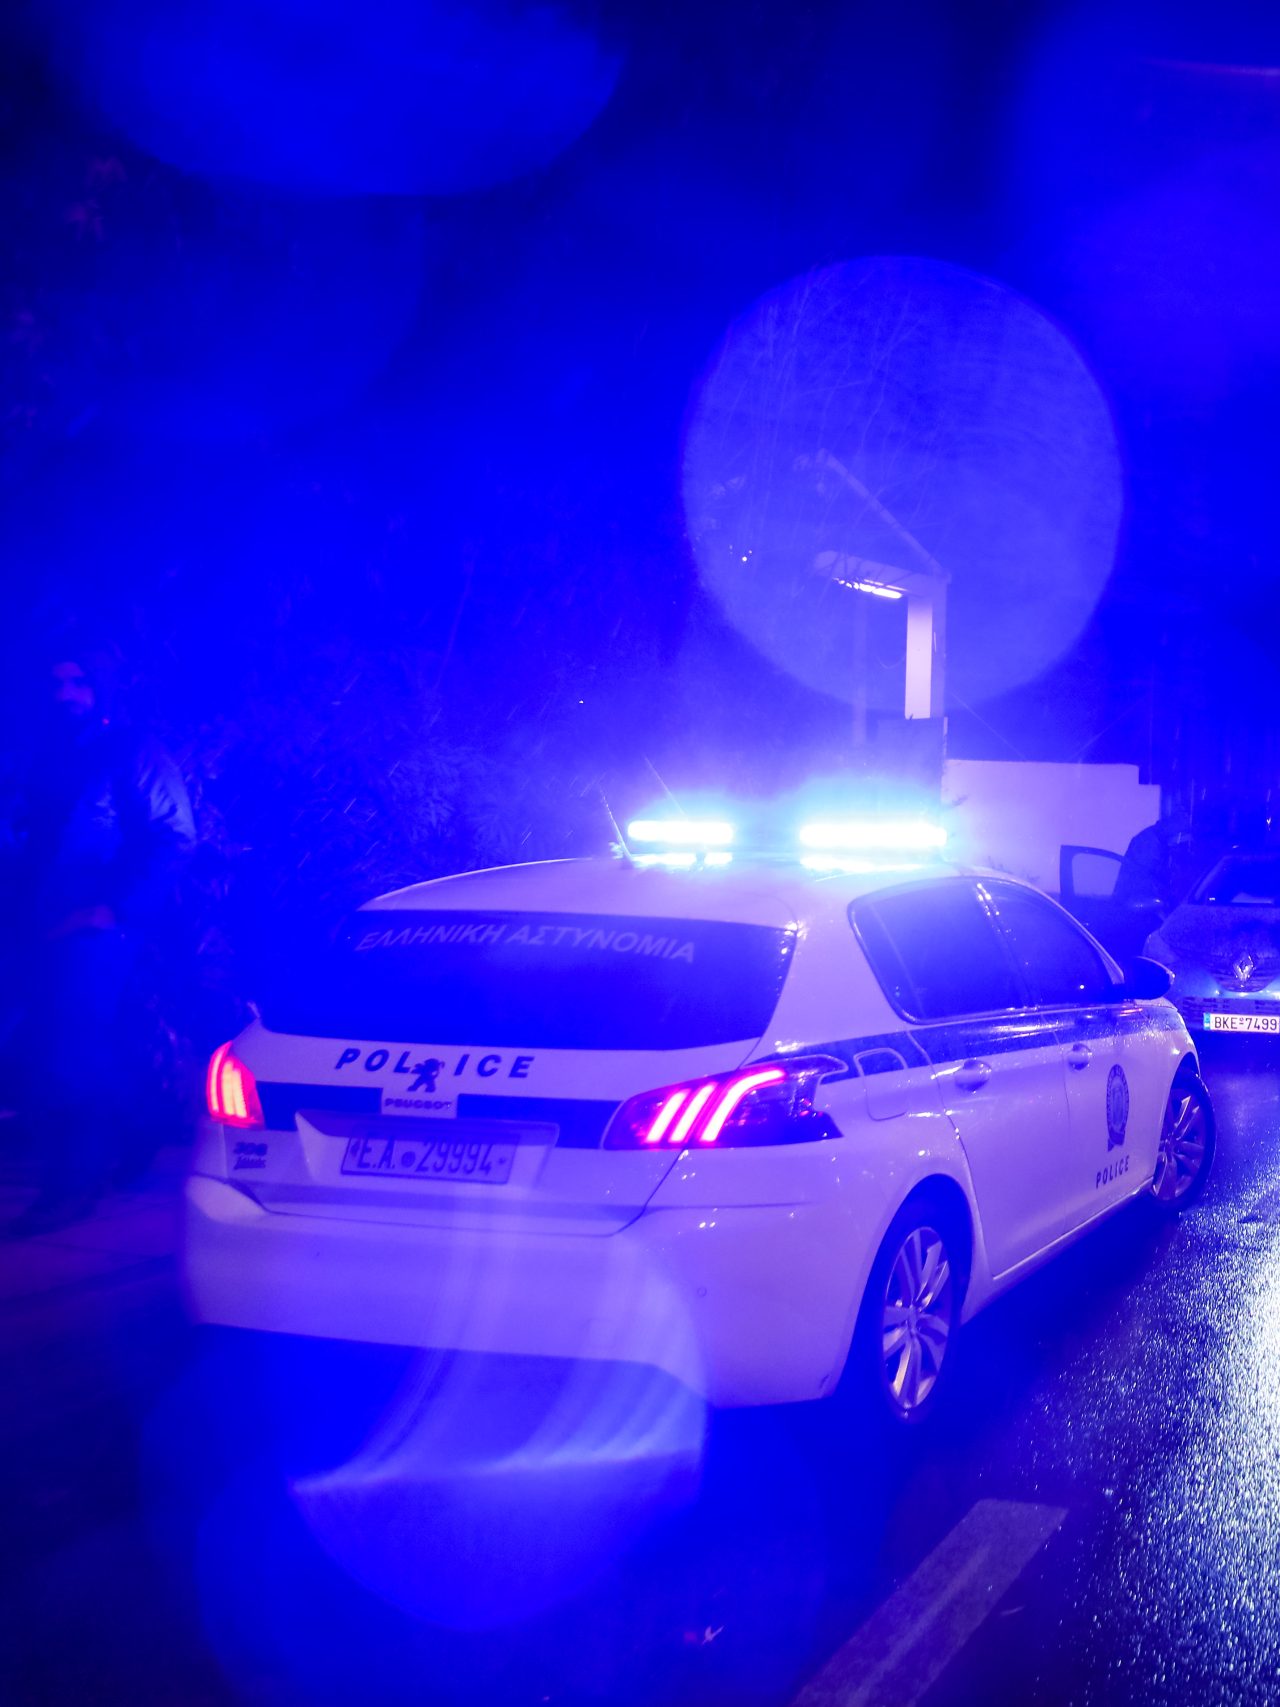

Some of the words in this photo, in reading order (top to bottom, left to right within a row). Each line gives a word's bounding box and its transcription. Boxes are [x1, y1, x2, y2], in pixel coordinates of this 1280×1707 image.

[355, 924, 503, 952] ΕΛΛΗΝΙΚΗ
[506, 925, 695, 964] ΑΣΤΥΝΟΜΙΑ
[334, 1048, 535, 1079] POLICE
[1095, 1155, 1130, 1190] POLICE
